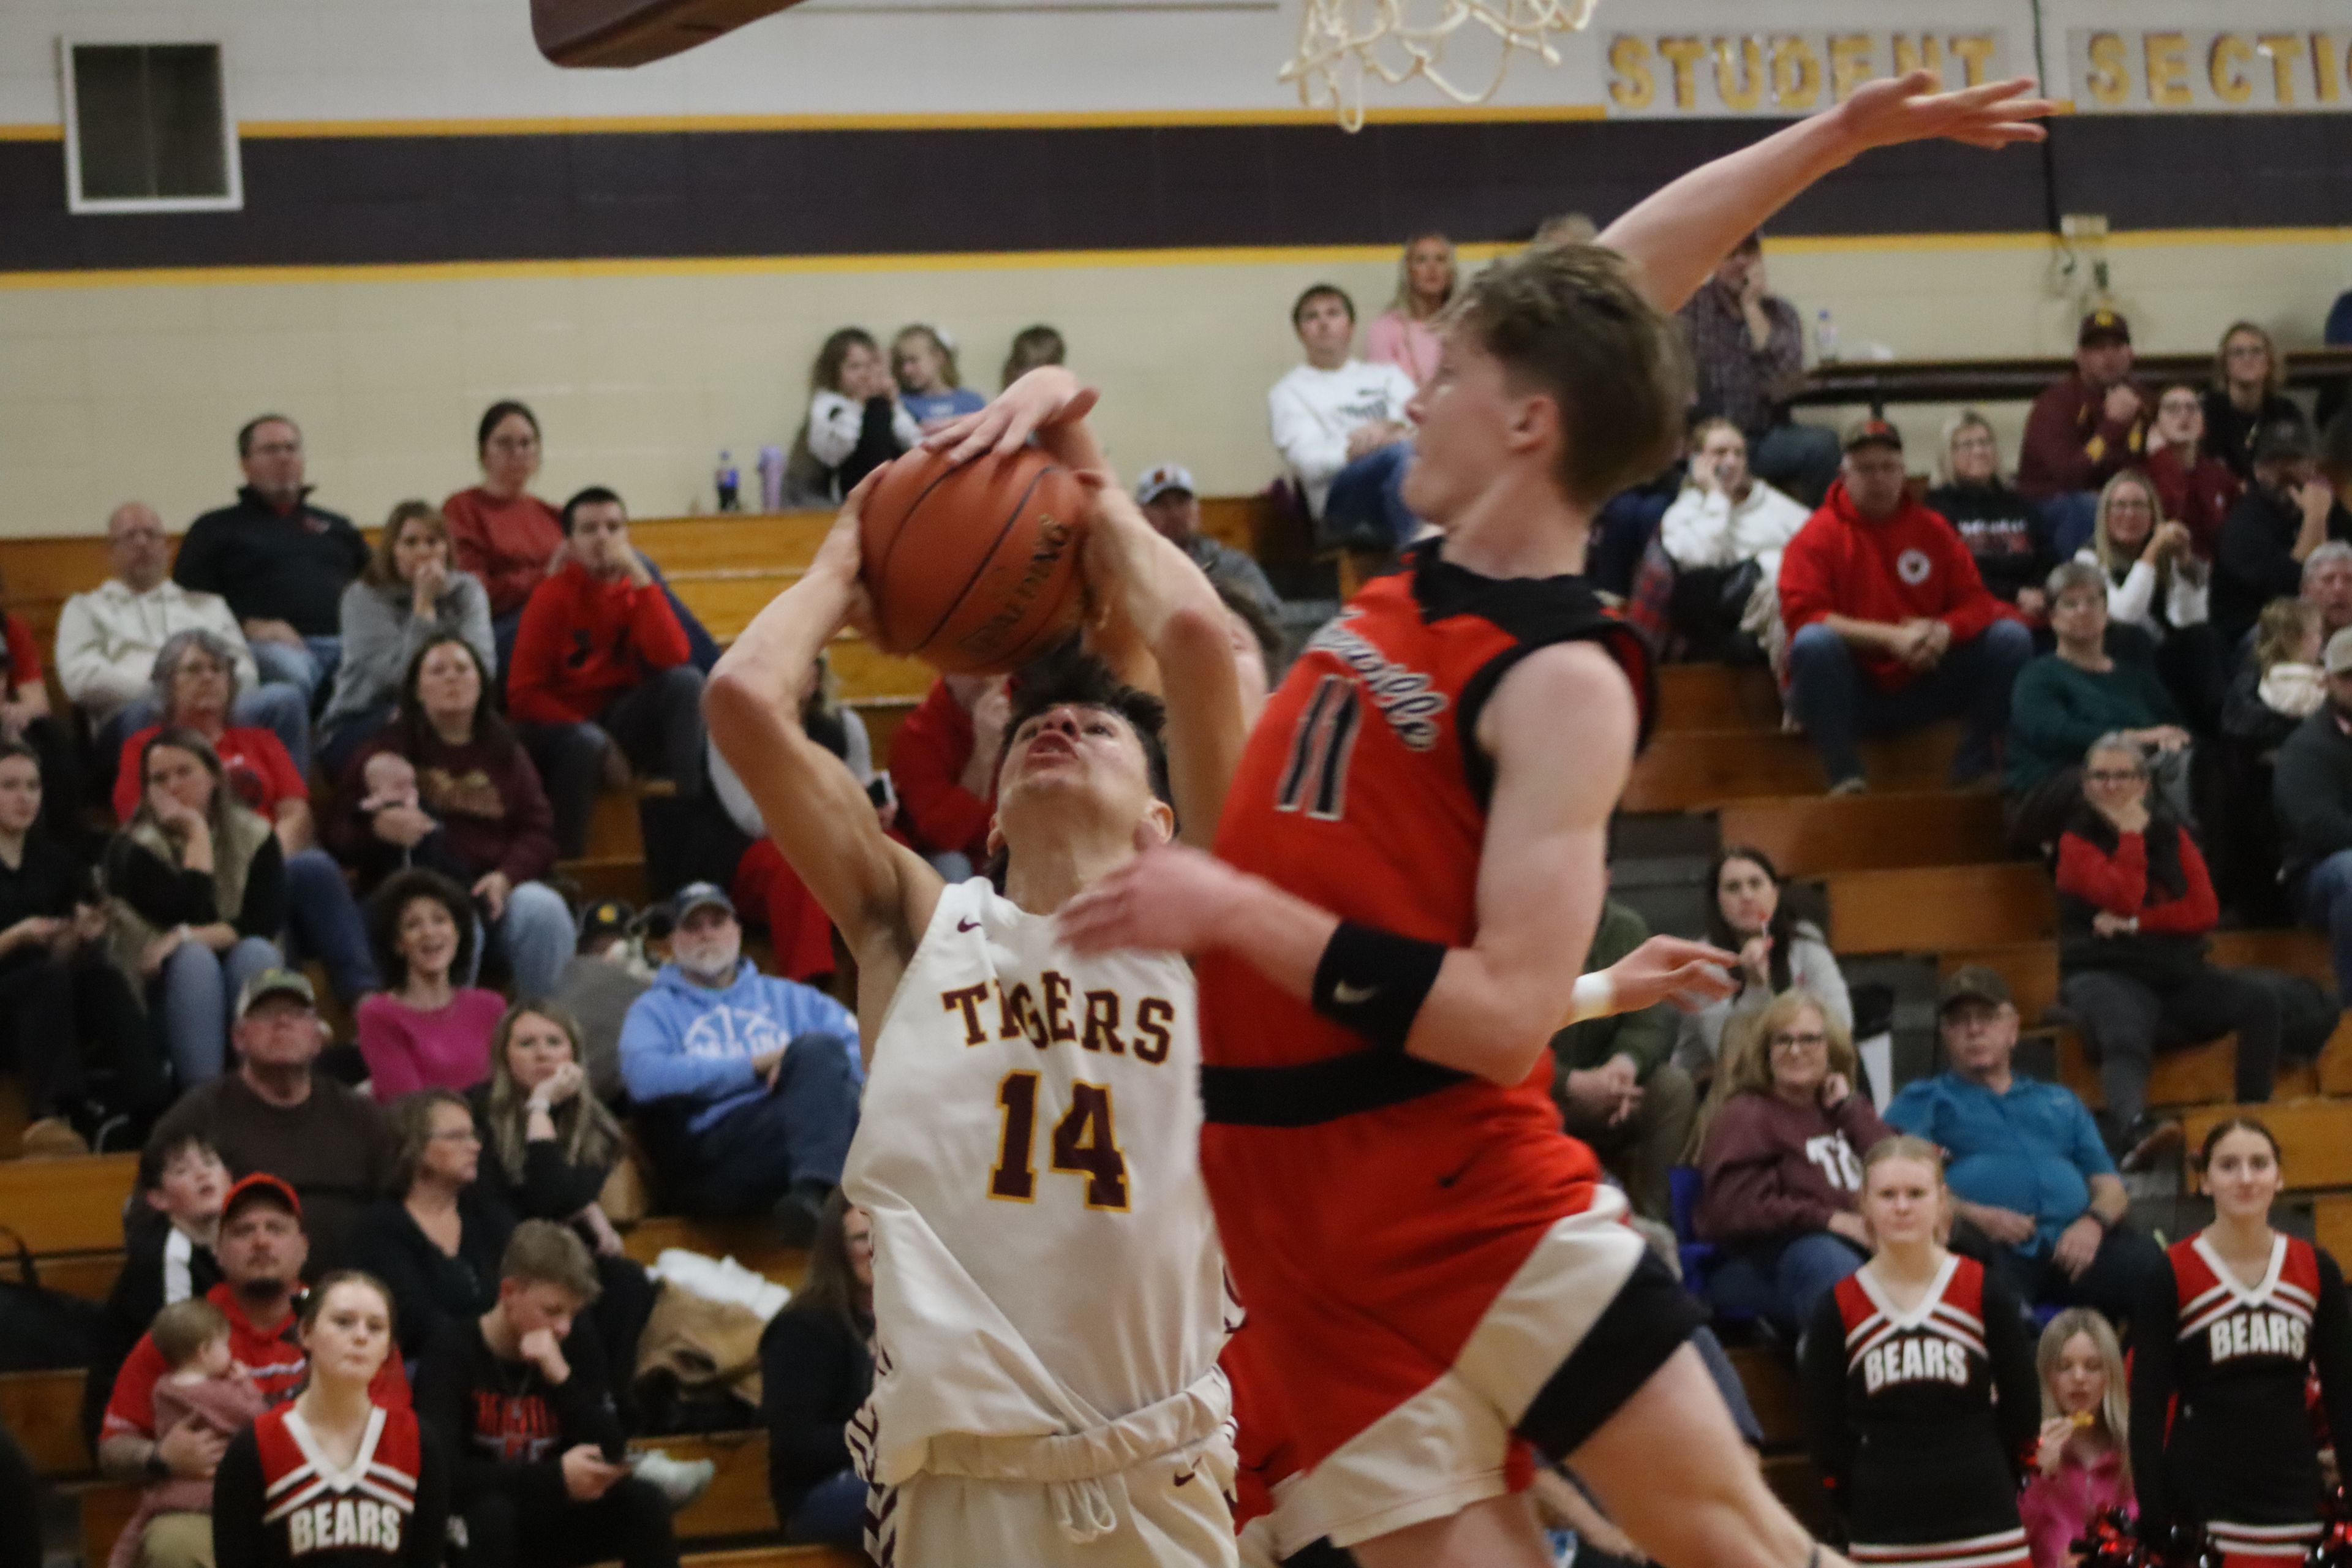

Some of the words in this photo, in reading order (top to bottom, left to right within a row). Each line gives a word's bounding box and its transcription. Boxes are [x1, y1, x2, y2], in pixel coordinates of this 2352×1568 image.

[1608, 34, 1996, 111] STUDENT
[2086, 32, 2352, 104] SECTI
[1273, 673, 1361, 822] 11
[941, 970, 1175, 1066] TIGERS
[986, 1068, 1131, 1213] 14
[1864, 1336, 1969, 1395] BEARS
[2210, 1312, 2306, 1363] BEARS
[288, 1499, 401, 1556] BEARS
